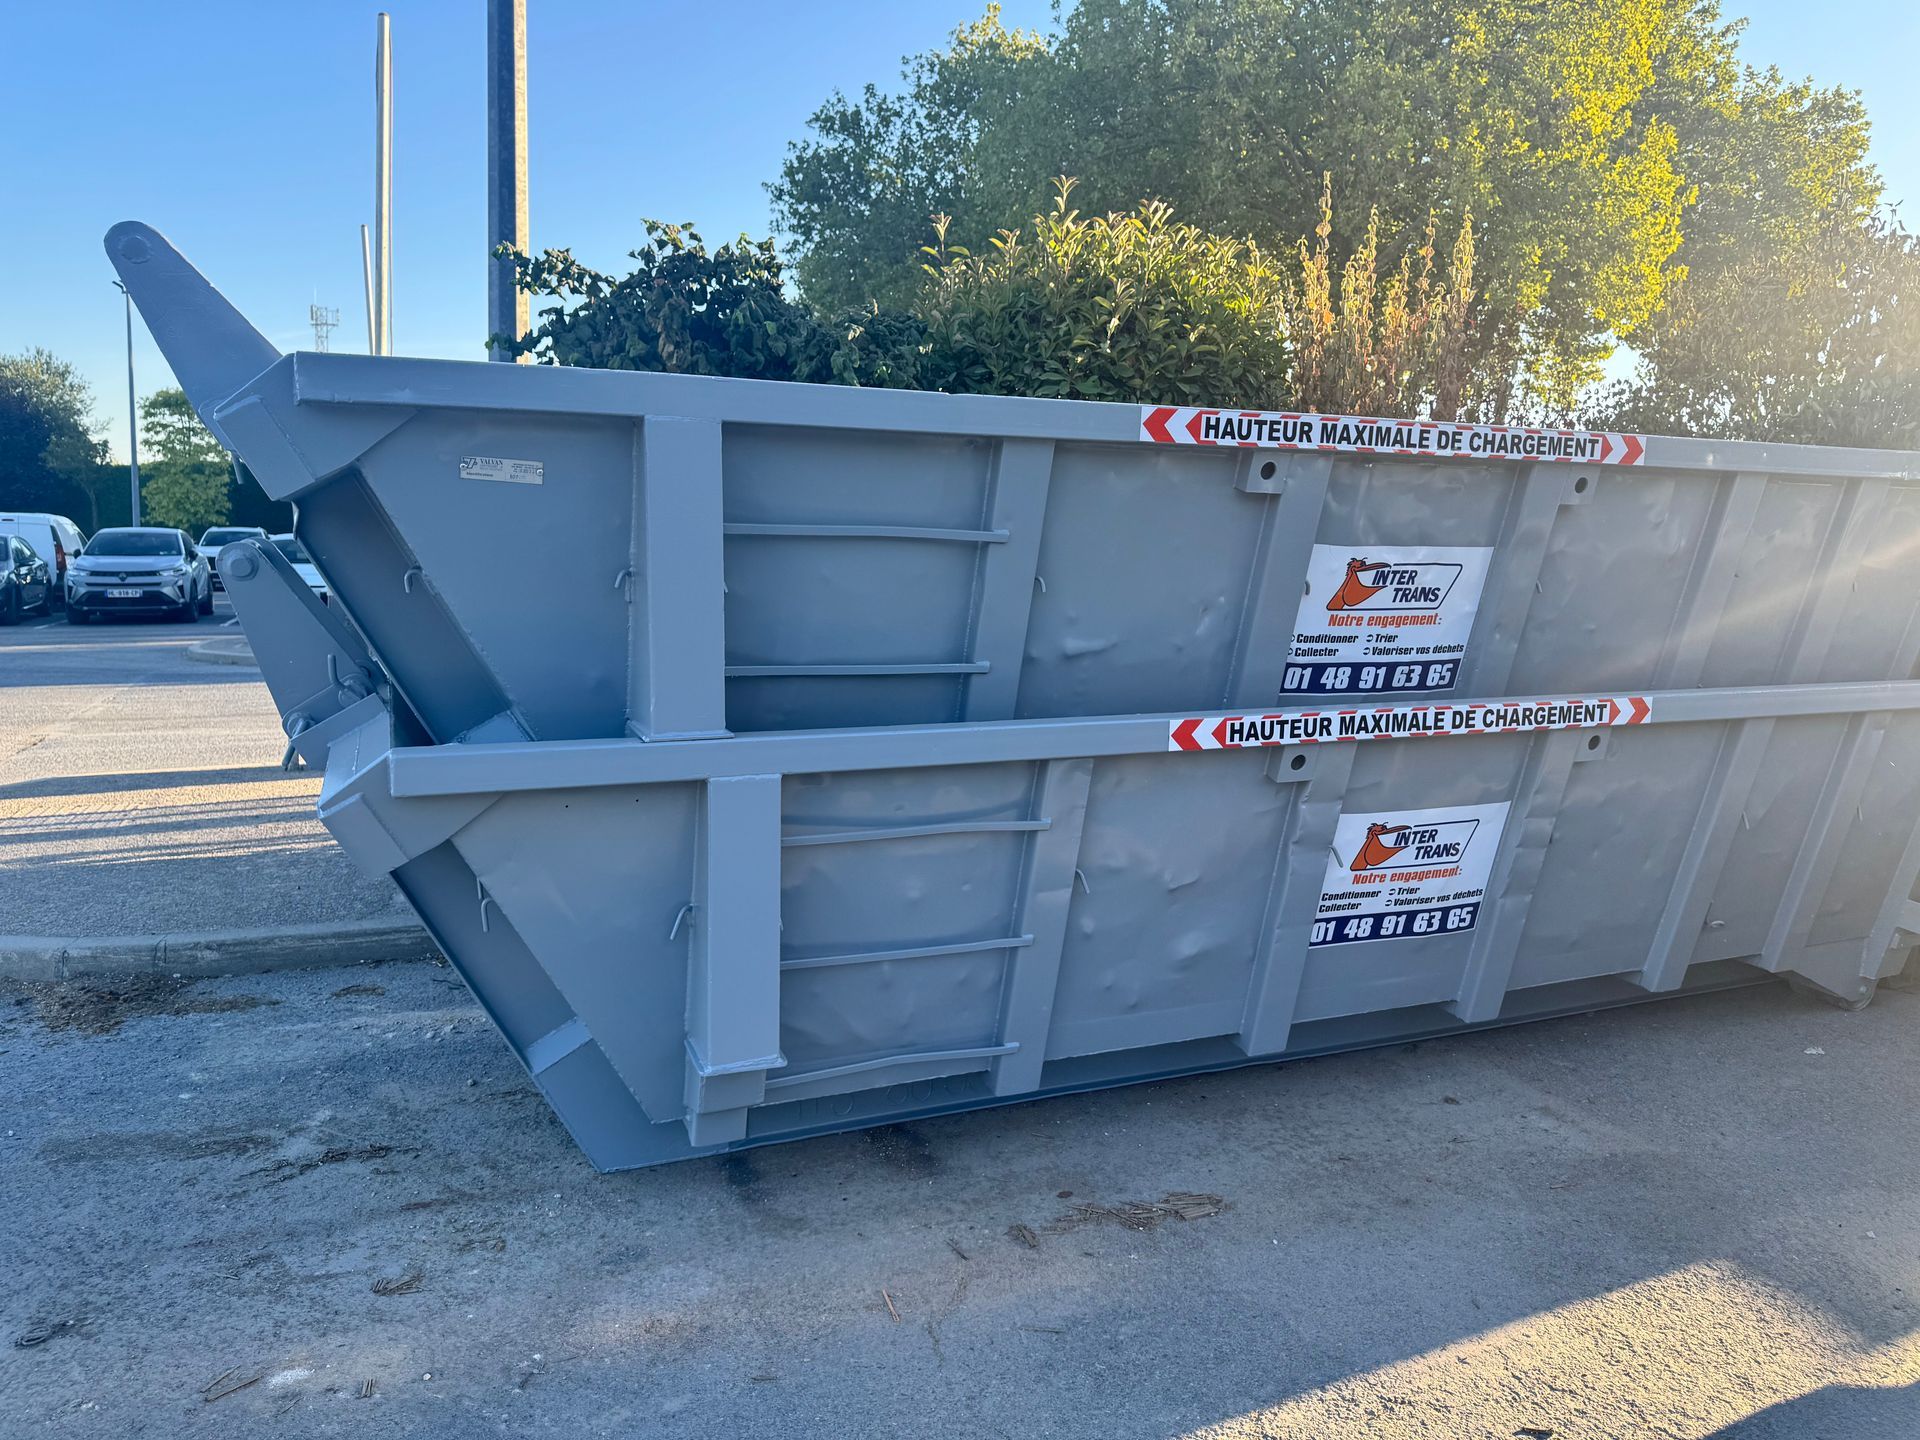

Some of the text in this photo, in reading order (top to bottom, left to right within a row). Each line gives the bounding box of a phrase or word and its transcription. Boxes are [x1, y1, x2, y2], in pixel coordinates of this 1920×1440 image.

[1204, 416, 1600, 458] HAUTEUR MAXIMALE DE CHARGEMENT
[1371, 569, 1418, 585] INTER
[1391, 587, 1441, 603] TRANS
[1327, 613, 1442, 628] Notre engagement:
[1296, 634, 1359, 644] Conditionner
[1374, 634, 1398, 643] Trier
[1294, 647, 1339, 657] Collecter
[1371, 643, 1464, 656] Valoriser vos déchets
[1283, 663, 1454, 690] 01 48 91 63 65
[1229, 703, 1608, 743] HAUTEUR MAXIMALE DE CHARGEMENT
[1393, 829, 1439, 847] INTER
[1414, 842, 1461, 860] TRANS
[1352, 865, 1463, 885] Notre engagement:
[1321, 889, 1382, 902] Conditionner
[1393, 888, 1484, 907] Valoriser vos déchets
[1397, 886, 1420, 896] Trier
[1318, 901, 1362, 913] Collecter
[1310, 907, 1474, 943] 01 48 91 63 65
